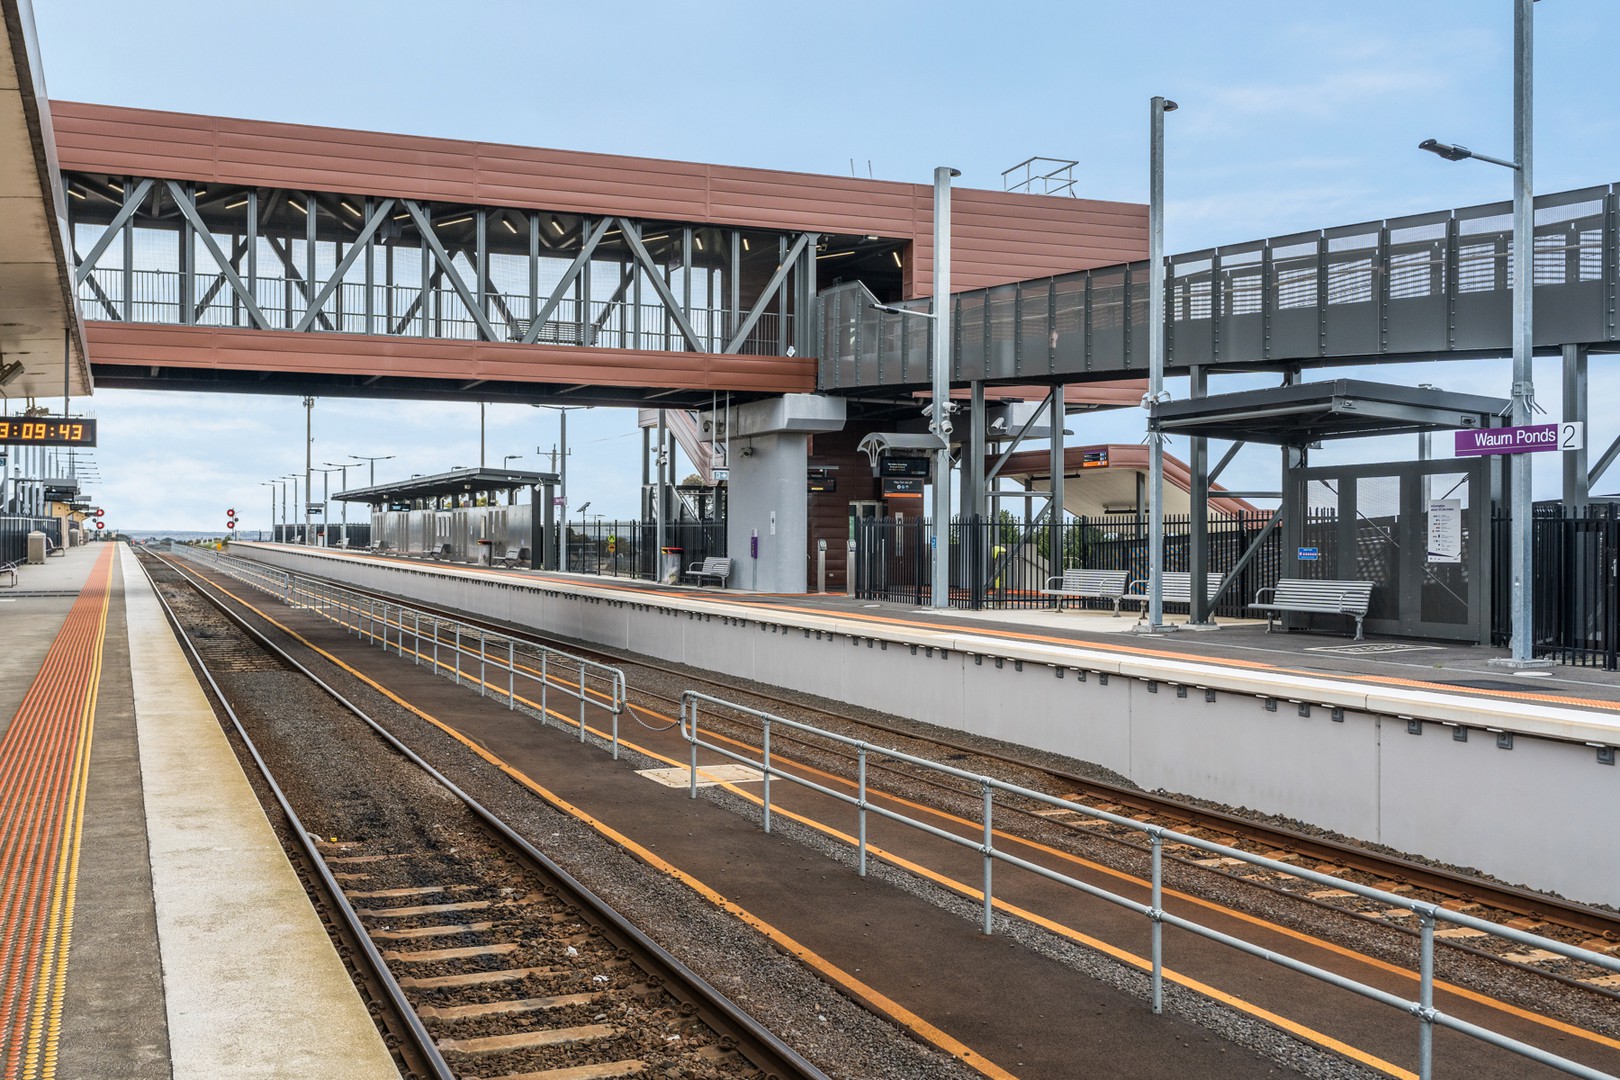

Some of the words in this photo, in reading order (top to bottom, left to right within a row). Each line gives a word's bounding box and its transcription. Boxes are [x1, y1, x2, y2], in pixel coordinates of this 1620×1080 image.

[1474, 432, 1513, 447] Waurn
[1516, 427, 1556, 444] Ponds
[1562, 424, 1576, 449] 2
